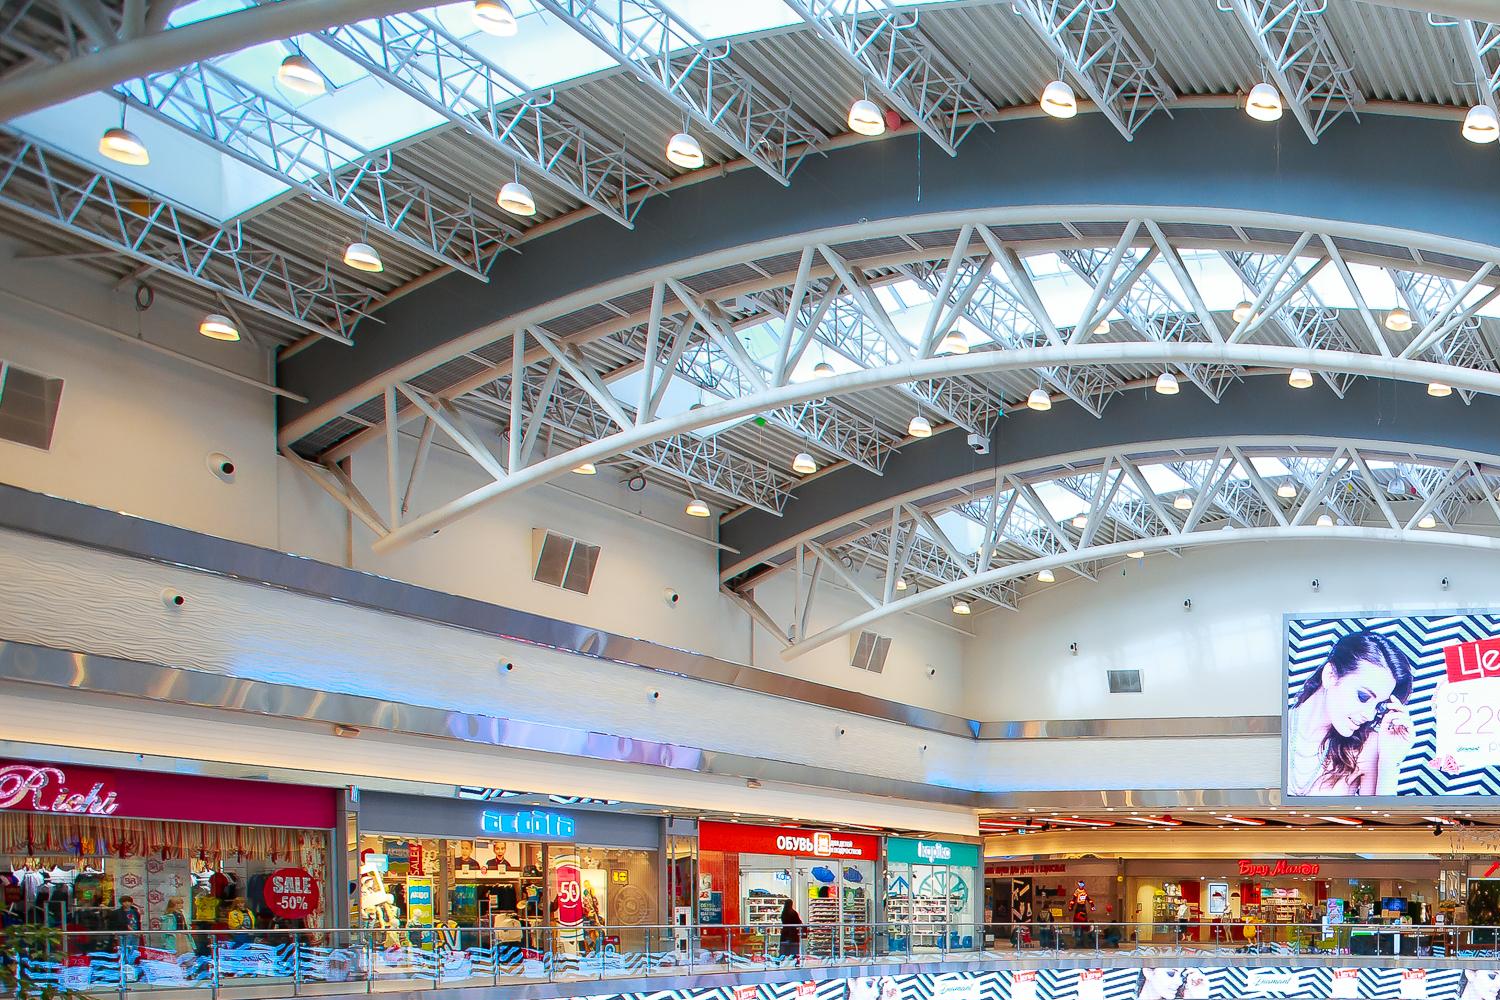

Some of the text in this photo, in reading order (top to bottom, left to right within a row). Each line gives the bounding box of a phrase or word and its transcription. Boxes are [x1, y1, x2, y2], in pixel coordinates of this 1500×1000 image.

[777, 835, 813, 852] ОБУВЬ
[1238, 859, 1319, 876] Буду Мамой
[272, 876, 312, 894] SALE
[276, 896, 308, 910] -50%
